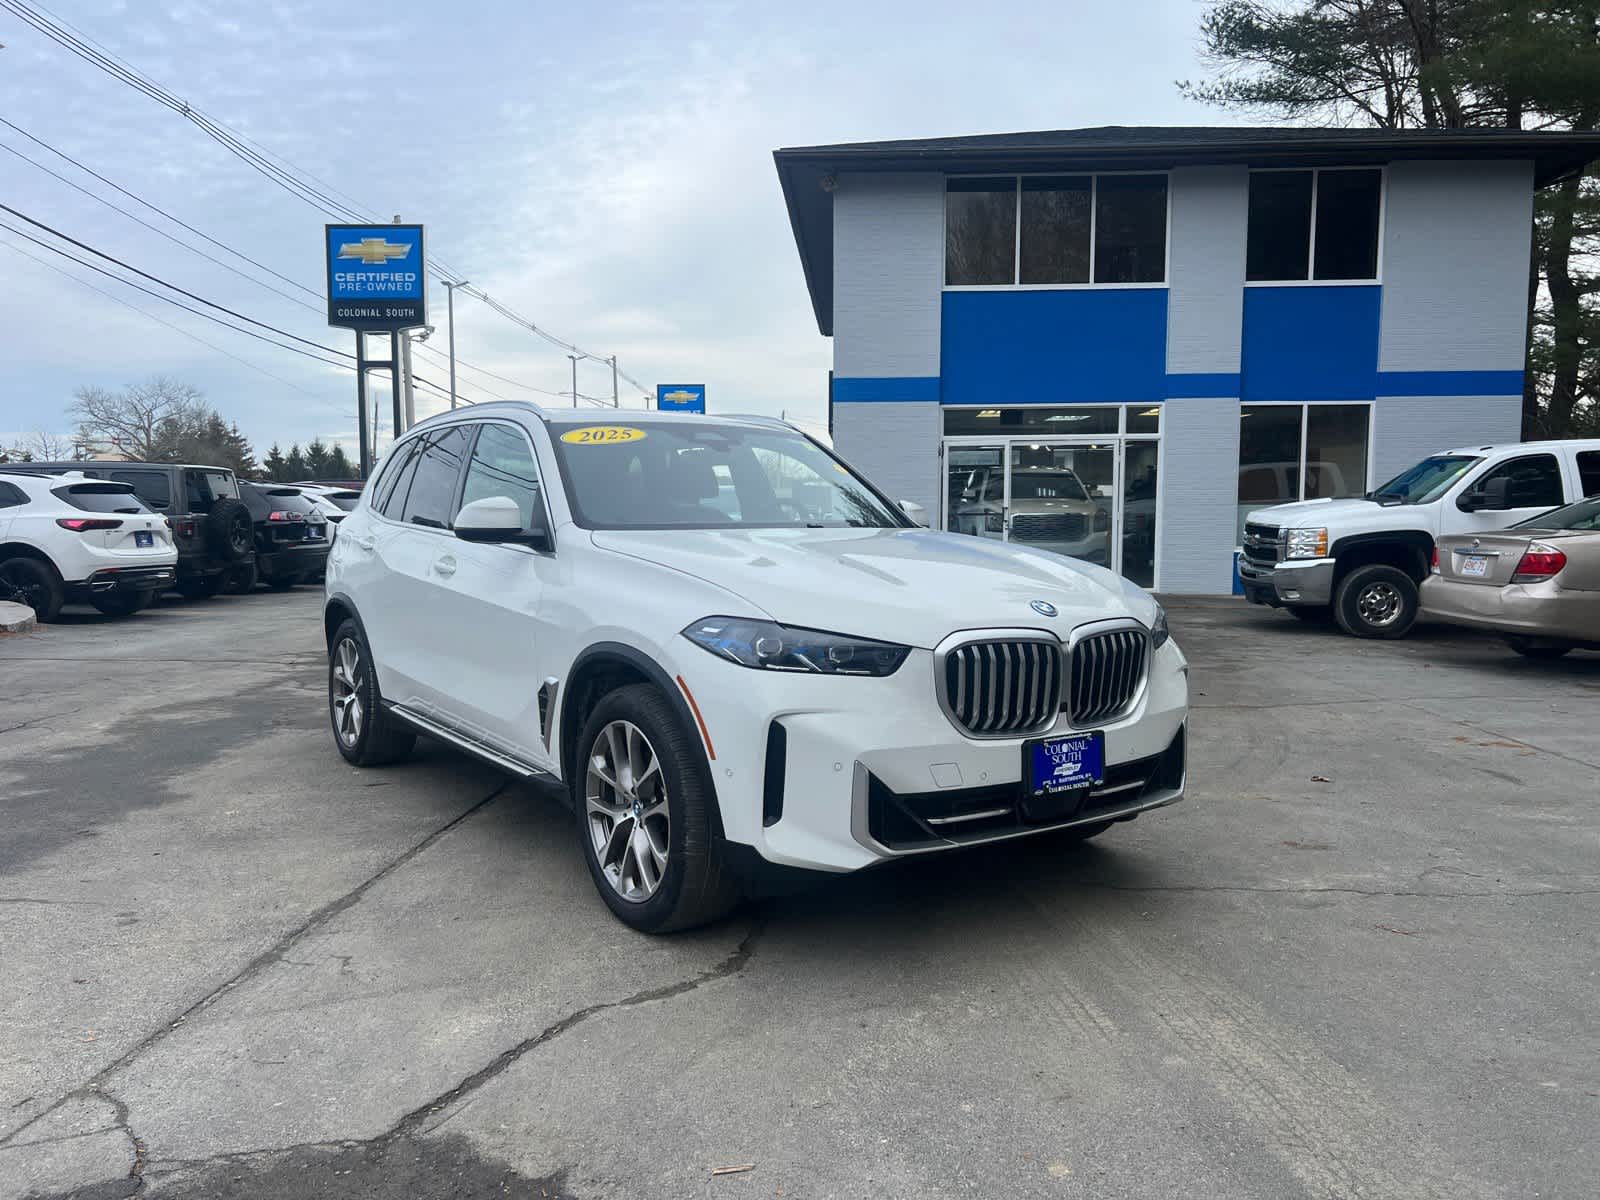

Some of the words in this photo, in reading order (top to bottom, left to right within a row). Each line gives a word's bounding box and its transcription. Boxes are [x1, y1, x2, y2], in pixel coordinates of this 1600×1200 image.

[335, 272, 416, 282] CERTIFIED
[339, 282, 412, 291] PRE-OWNED
[337, 308, 381, 317] COLONIAL
[386, 308, 415, 317] SOUTH
[578, 429, 632, 442] 2025
[1044, 740, 1088, 756] COLONIAL
[1052, 751, 1082, 765] SOUTH
